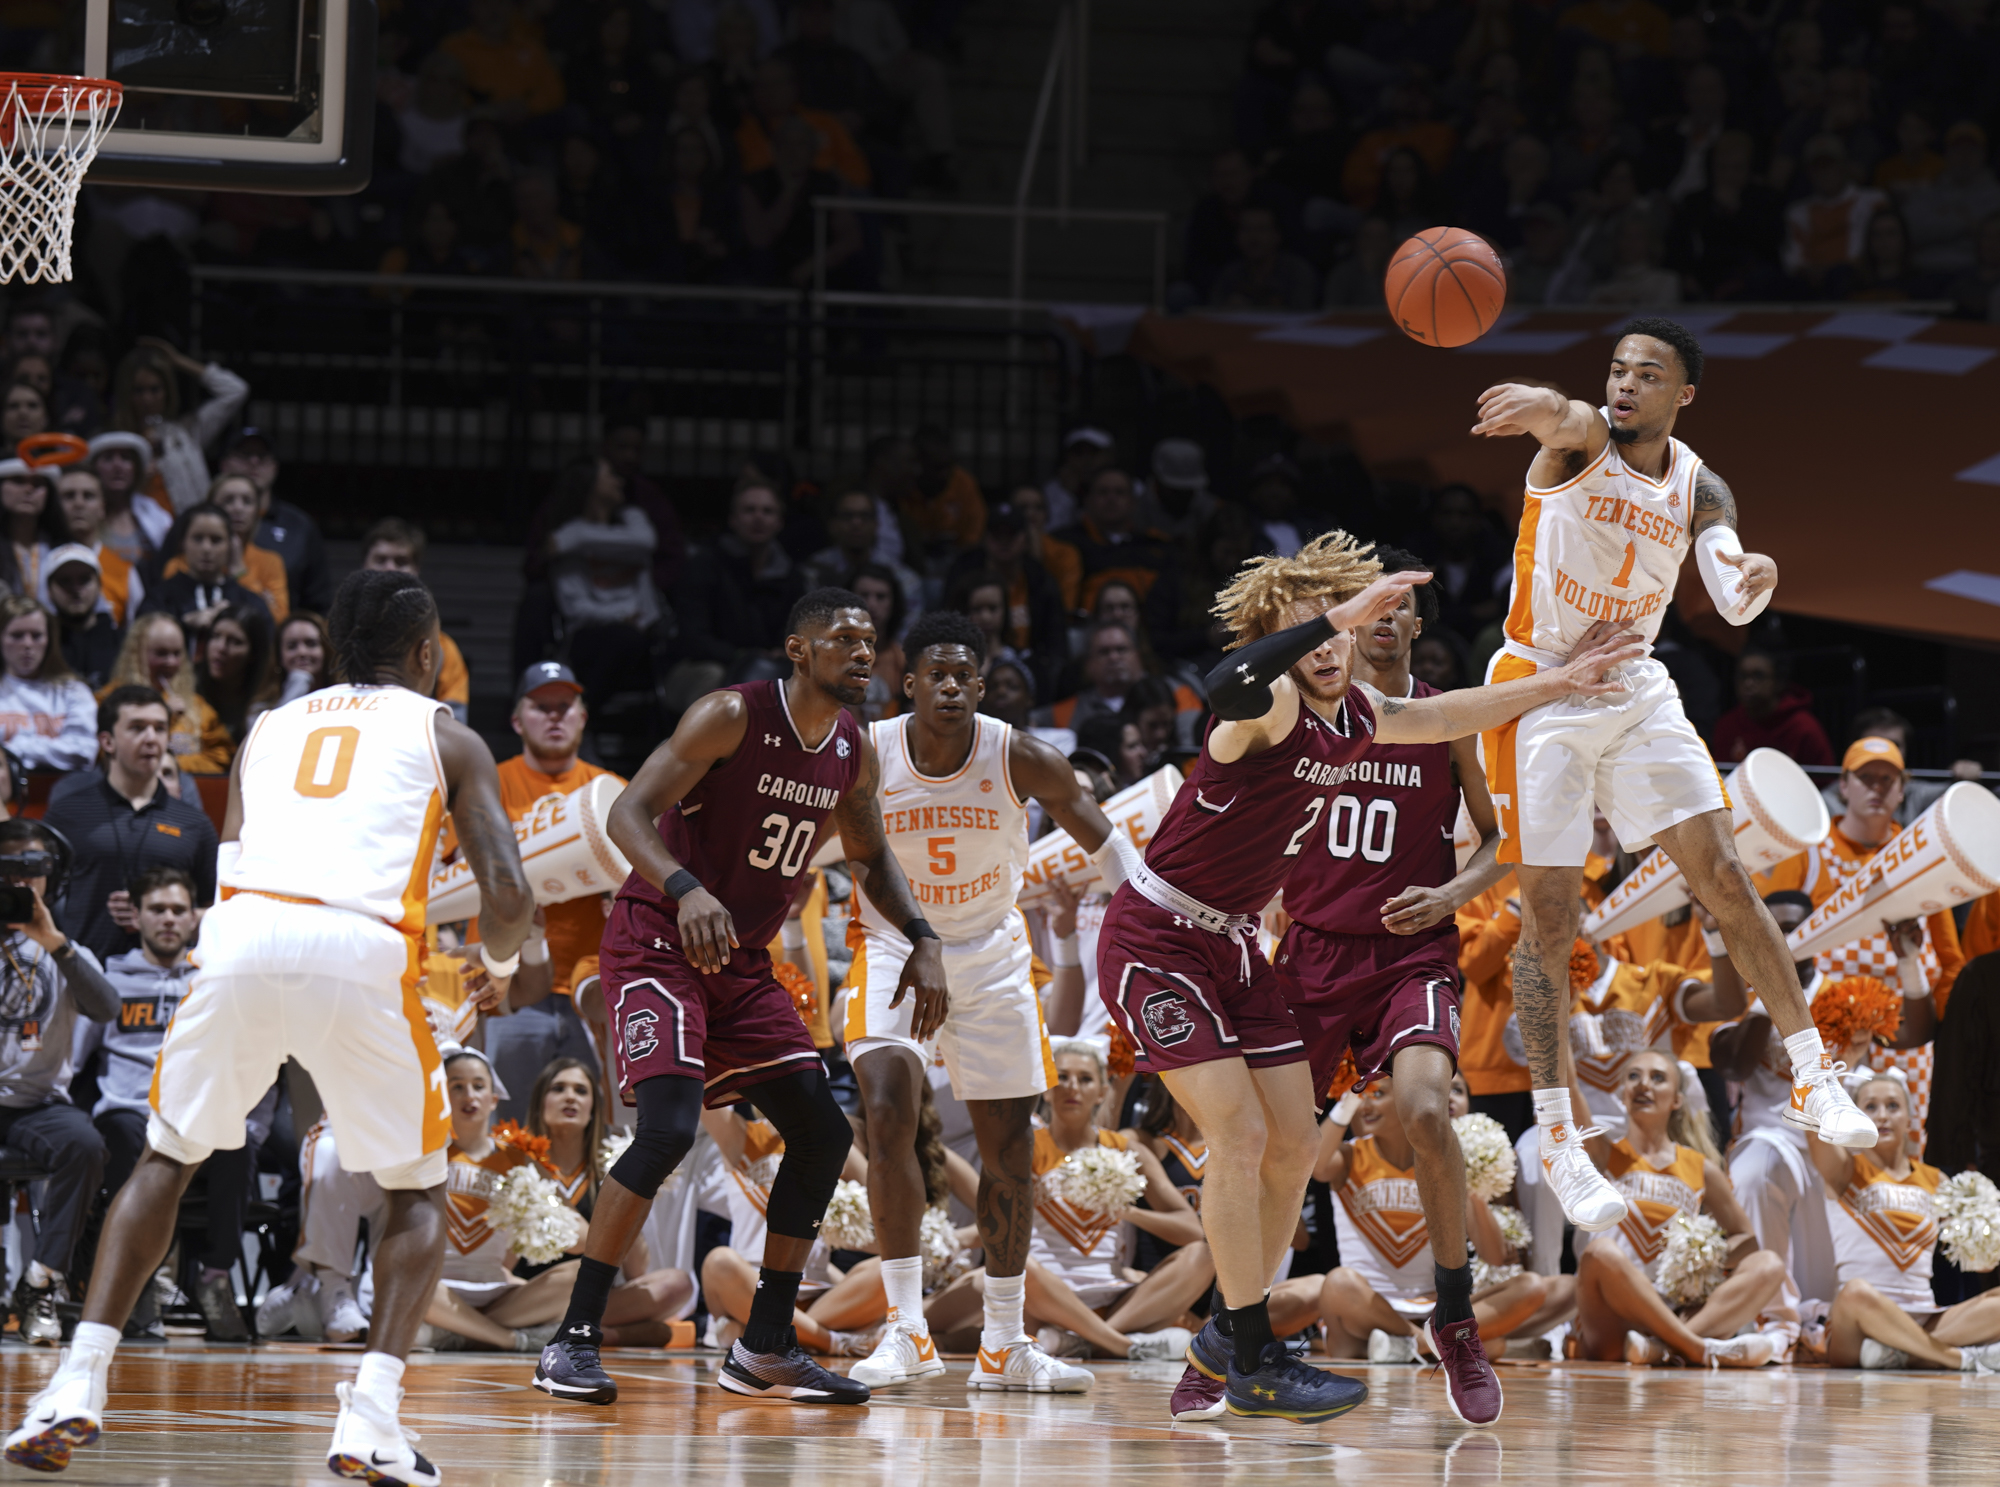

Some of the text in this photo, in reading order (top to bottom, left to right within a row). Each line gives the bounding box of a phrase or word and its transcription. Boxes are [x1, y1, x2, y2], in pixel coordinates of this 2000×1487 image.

[1611, 541, 1637, 589] 1
[1555, 568, 1666, 623] VOLUNTEERS
[306, 696, 389, 714] BONE
[293, 726, 361, 799] 0
[757, 773, 840, 810] CAROLINA
[748, 812, 816, 878] 30
[883, 805, 1000, 835] TENNESSEE
[1283, 797, 1326, 856] 2
[1328, 794, 1398, 863] 00
[928, 836, 956, 876] 5
[1796, 815, 1929, 940] TENNESSEE
